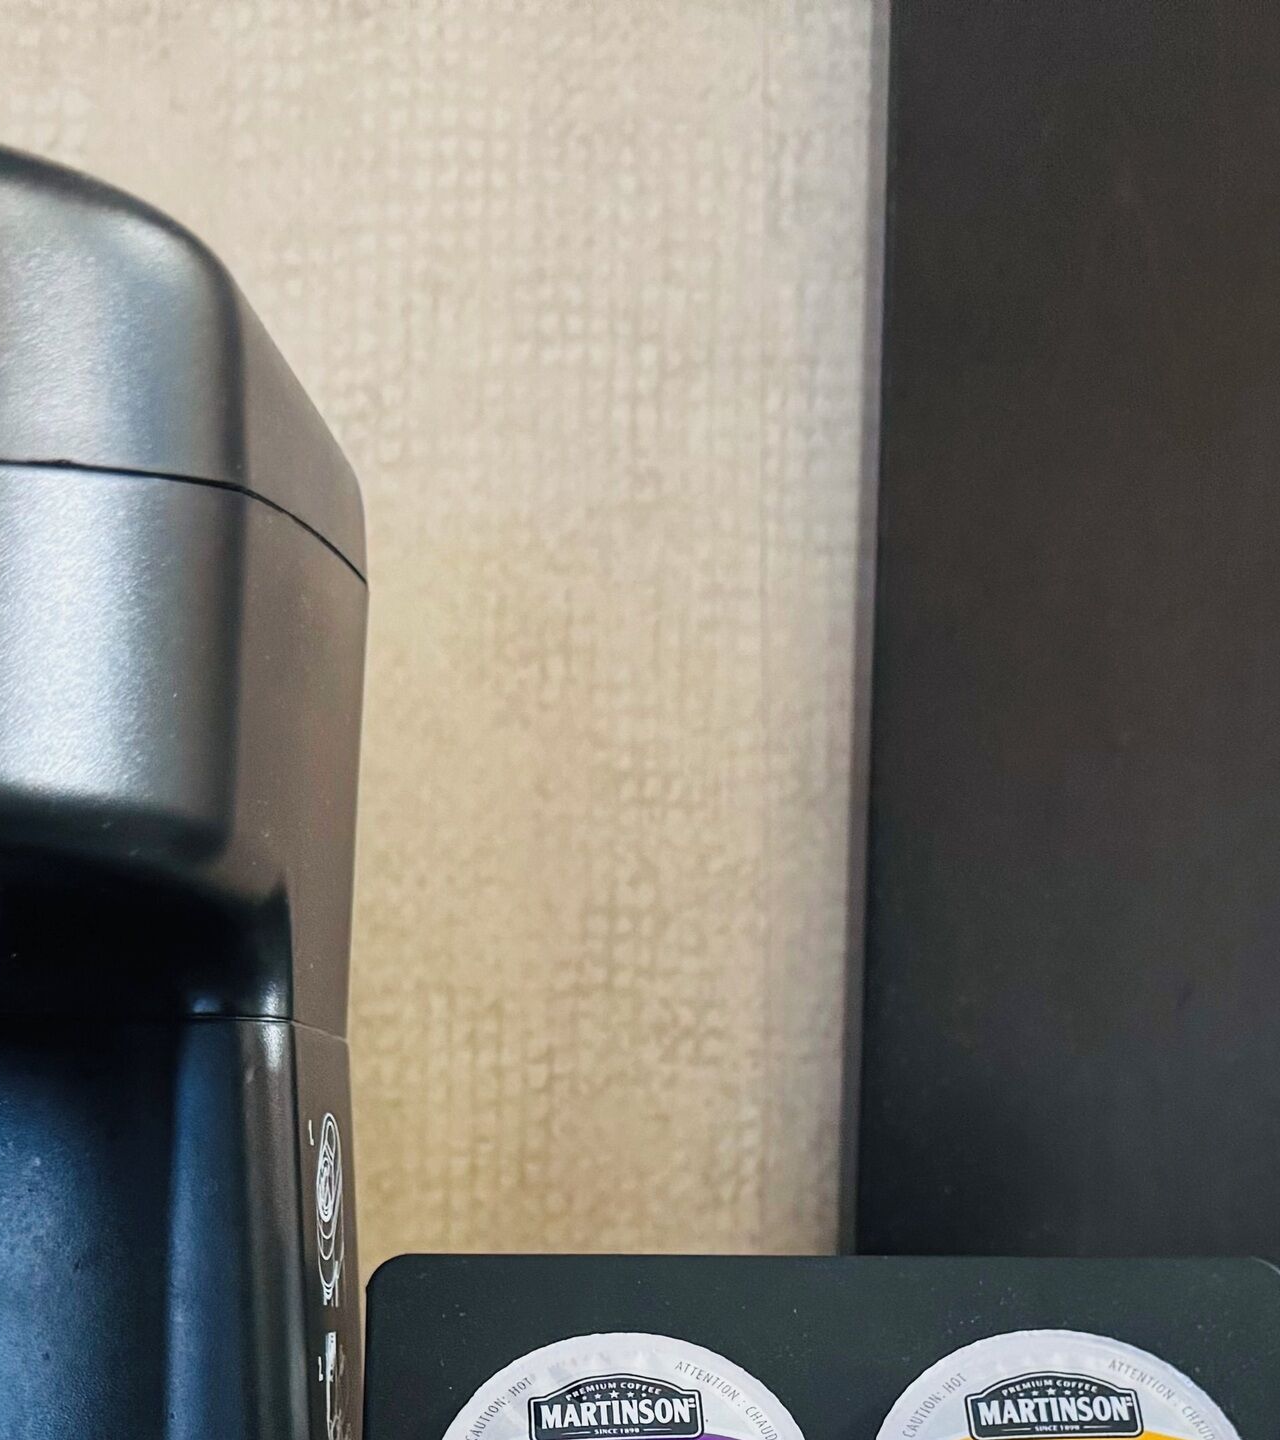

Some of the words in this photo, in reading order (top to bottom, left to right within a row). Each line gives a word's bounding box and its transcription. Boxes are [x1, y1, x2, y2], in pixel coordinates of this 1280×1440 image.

[508, 1376, 533, 1398] HOT
[565, 1382, 616, 1401] PREMIUM
[620, 1381, 662, 1395] COFFEE
[674, 1361, 741, 1401] ATTENTION
[1001, 1380, 1053, 1396] PREMIUM
[1056, 1380, 1098, 1393] COFFEE
[1108, 1359, 1176, 1400] ATTENTION
[540, 1397, 691, 1429] MARTINSON
[902, 1391, 945, 1438] CAUTION:
[943, 1372, 967, 1394] HOT
[977, 1395, 1130, 1426] MARTINSON
